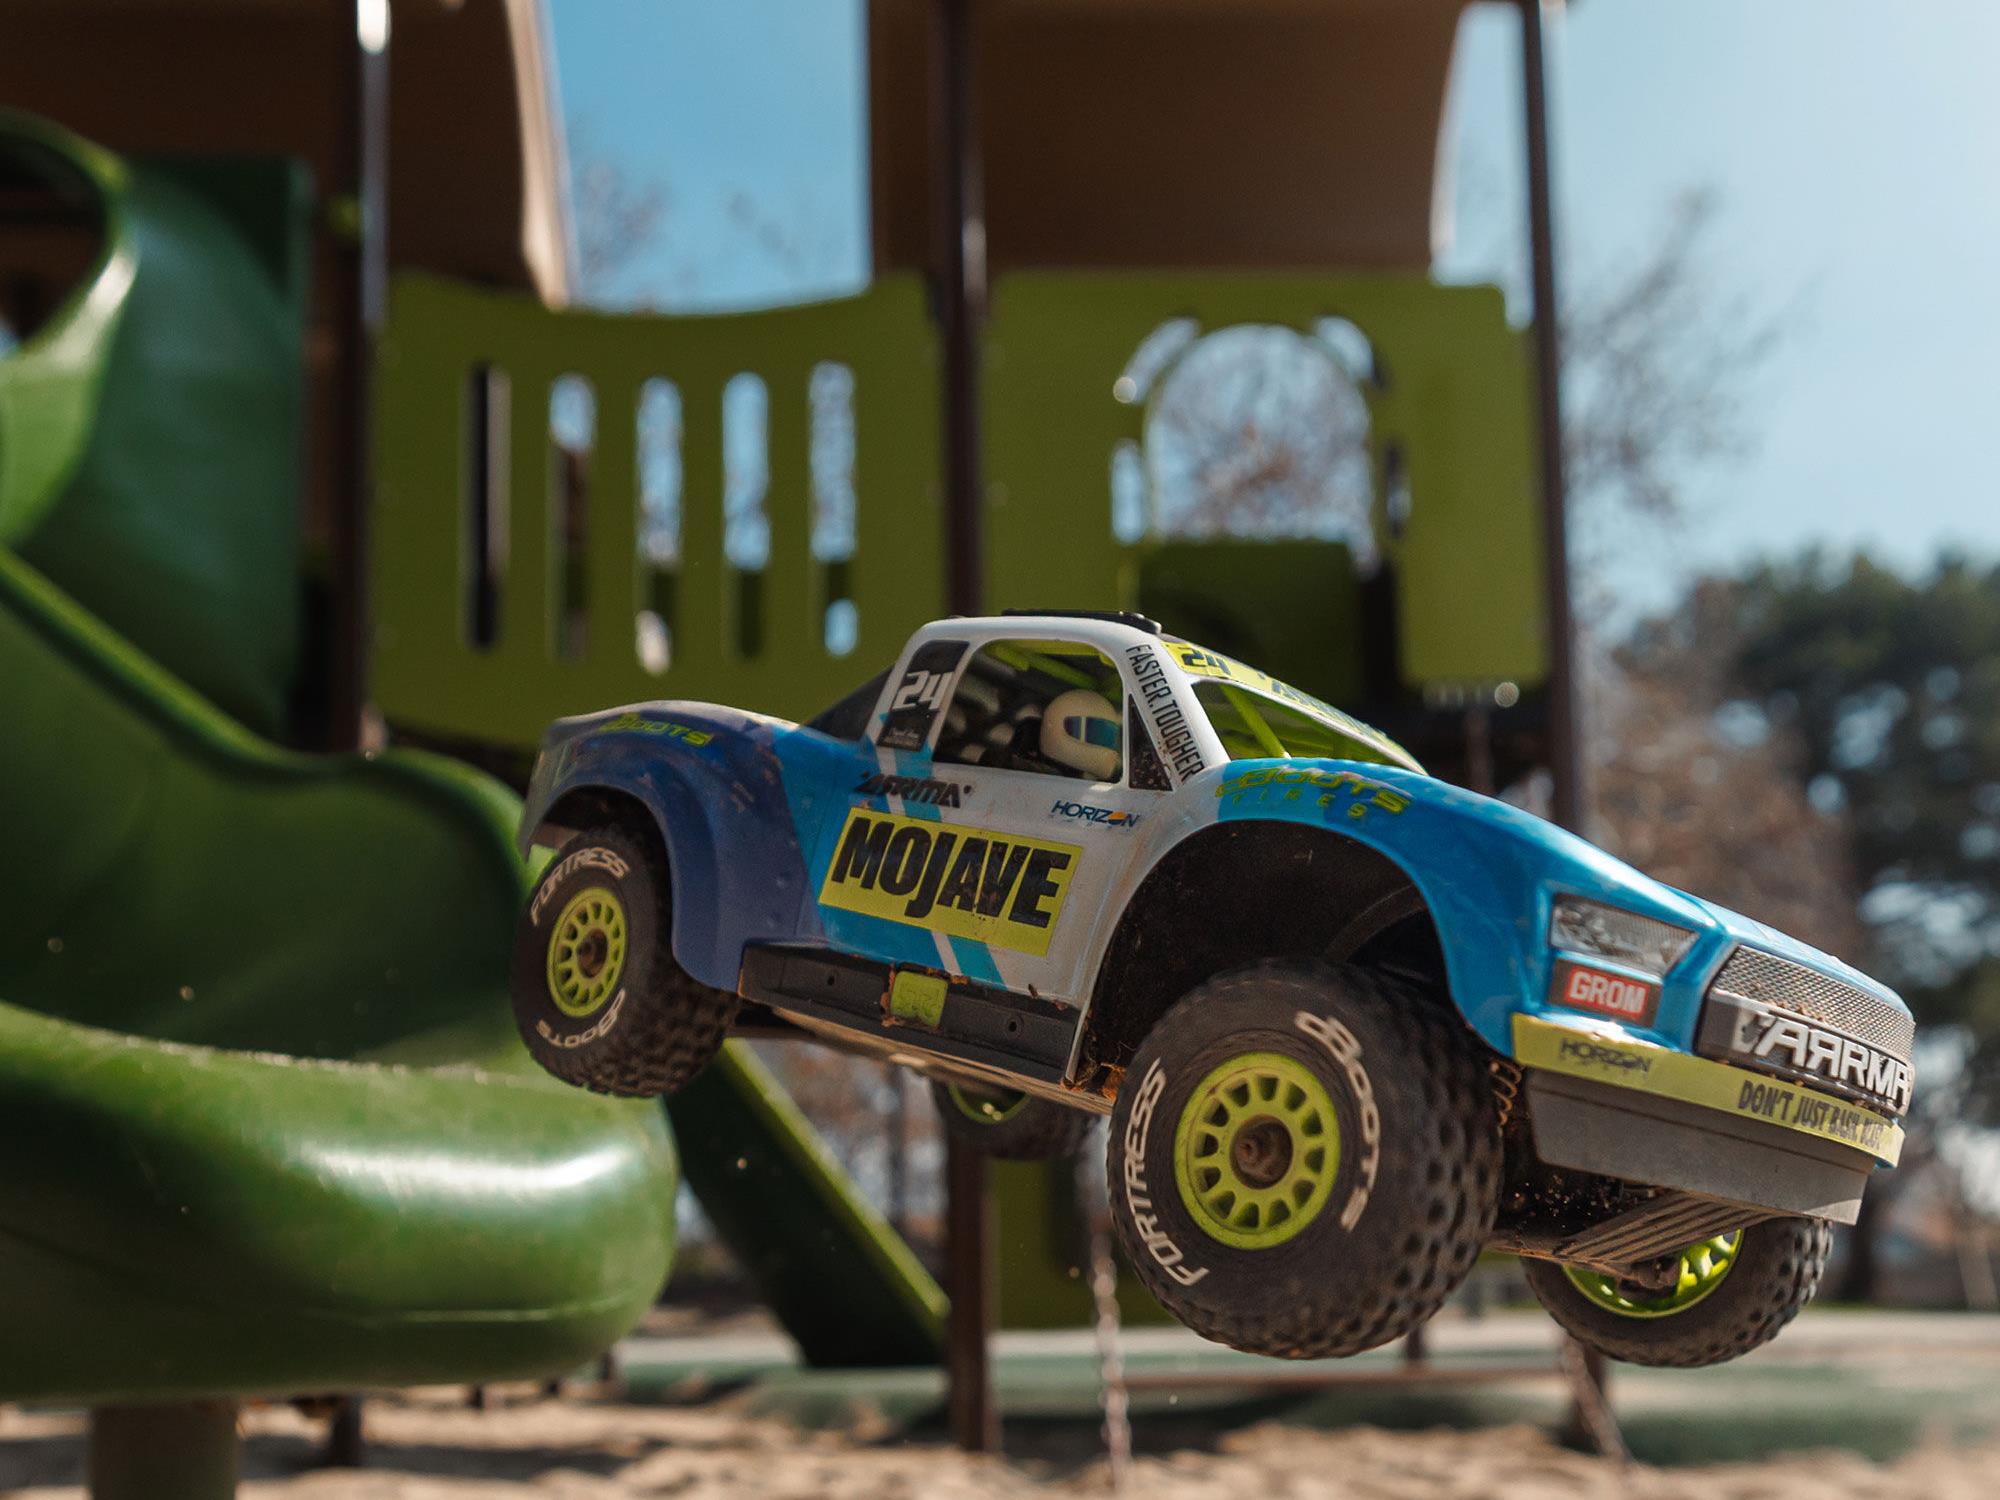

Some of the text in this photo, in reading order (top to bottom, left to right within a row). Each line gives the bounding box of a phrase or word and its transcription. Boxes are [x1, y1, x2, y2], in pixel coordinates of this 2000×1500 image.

[891, 669, 954, 710] 24
[1050, 800, 1140, 828] HORIZON
[530, 846, 631, 928] FORTRESS
[830, 816, 1072, 929] MOJAVE
[1569, 969, 1647, 1015] GROM
[1737, 1079, 1794, 1121] DON'T
[1792, 1095, 1832, 1131] JUST
[1123, 1056, 1210, 1287] FORTRESS
